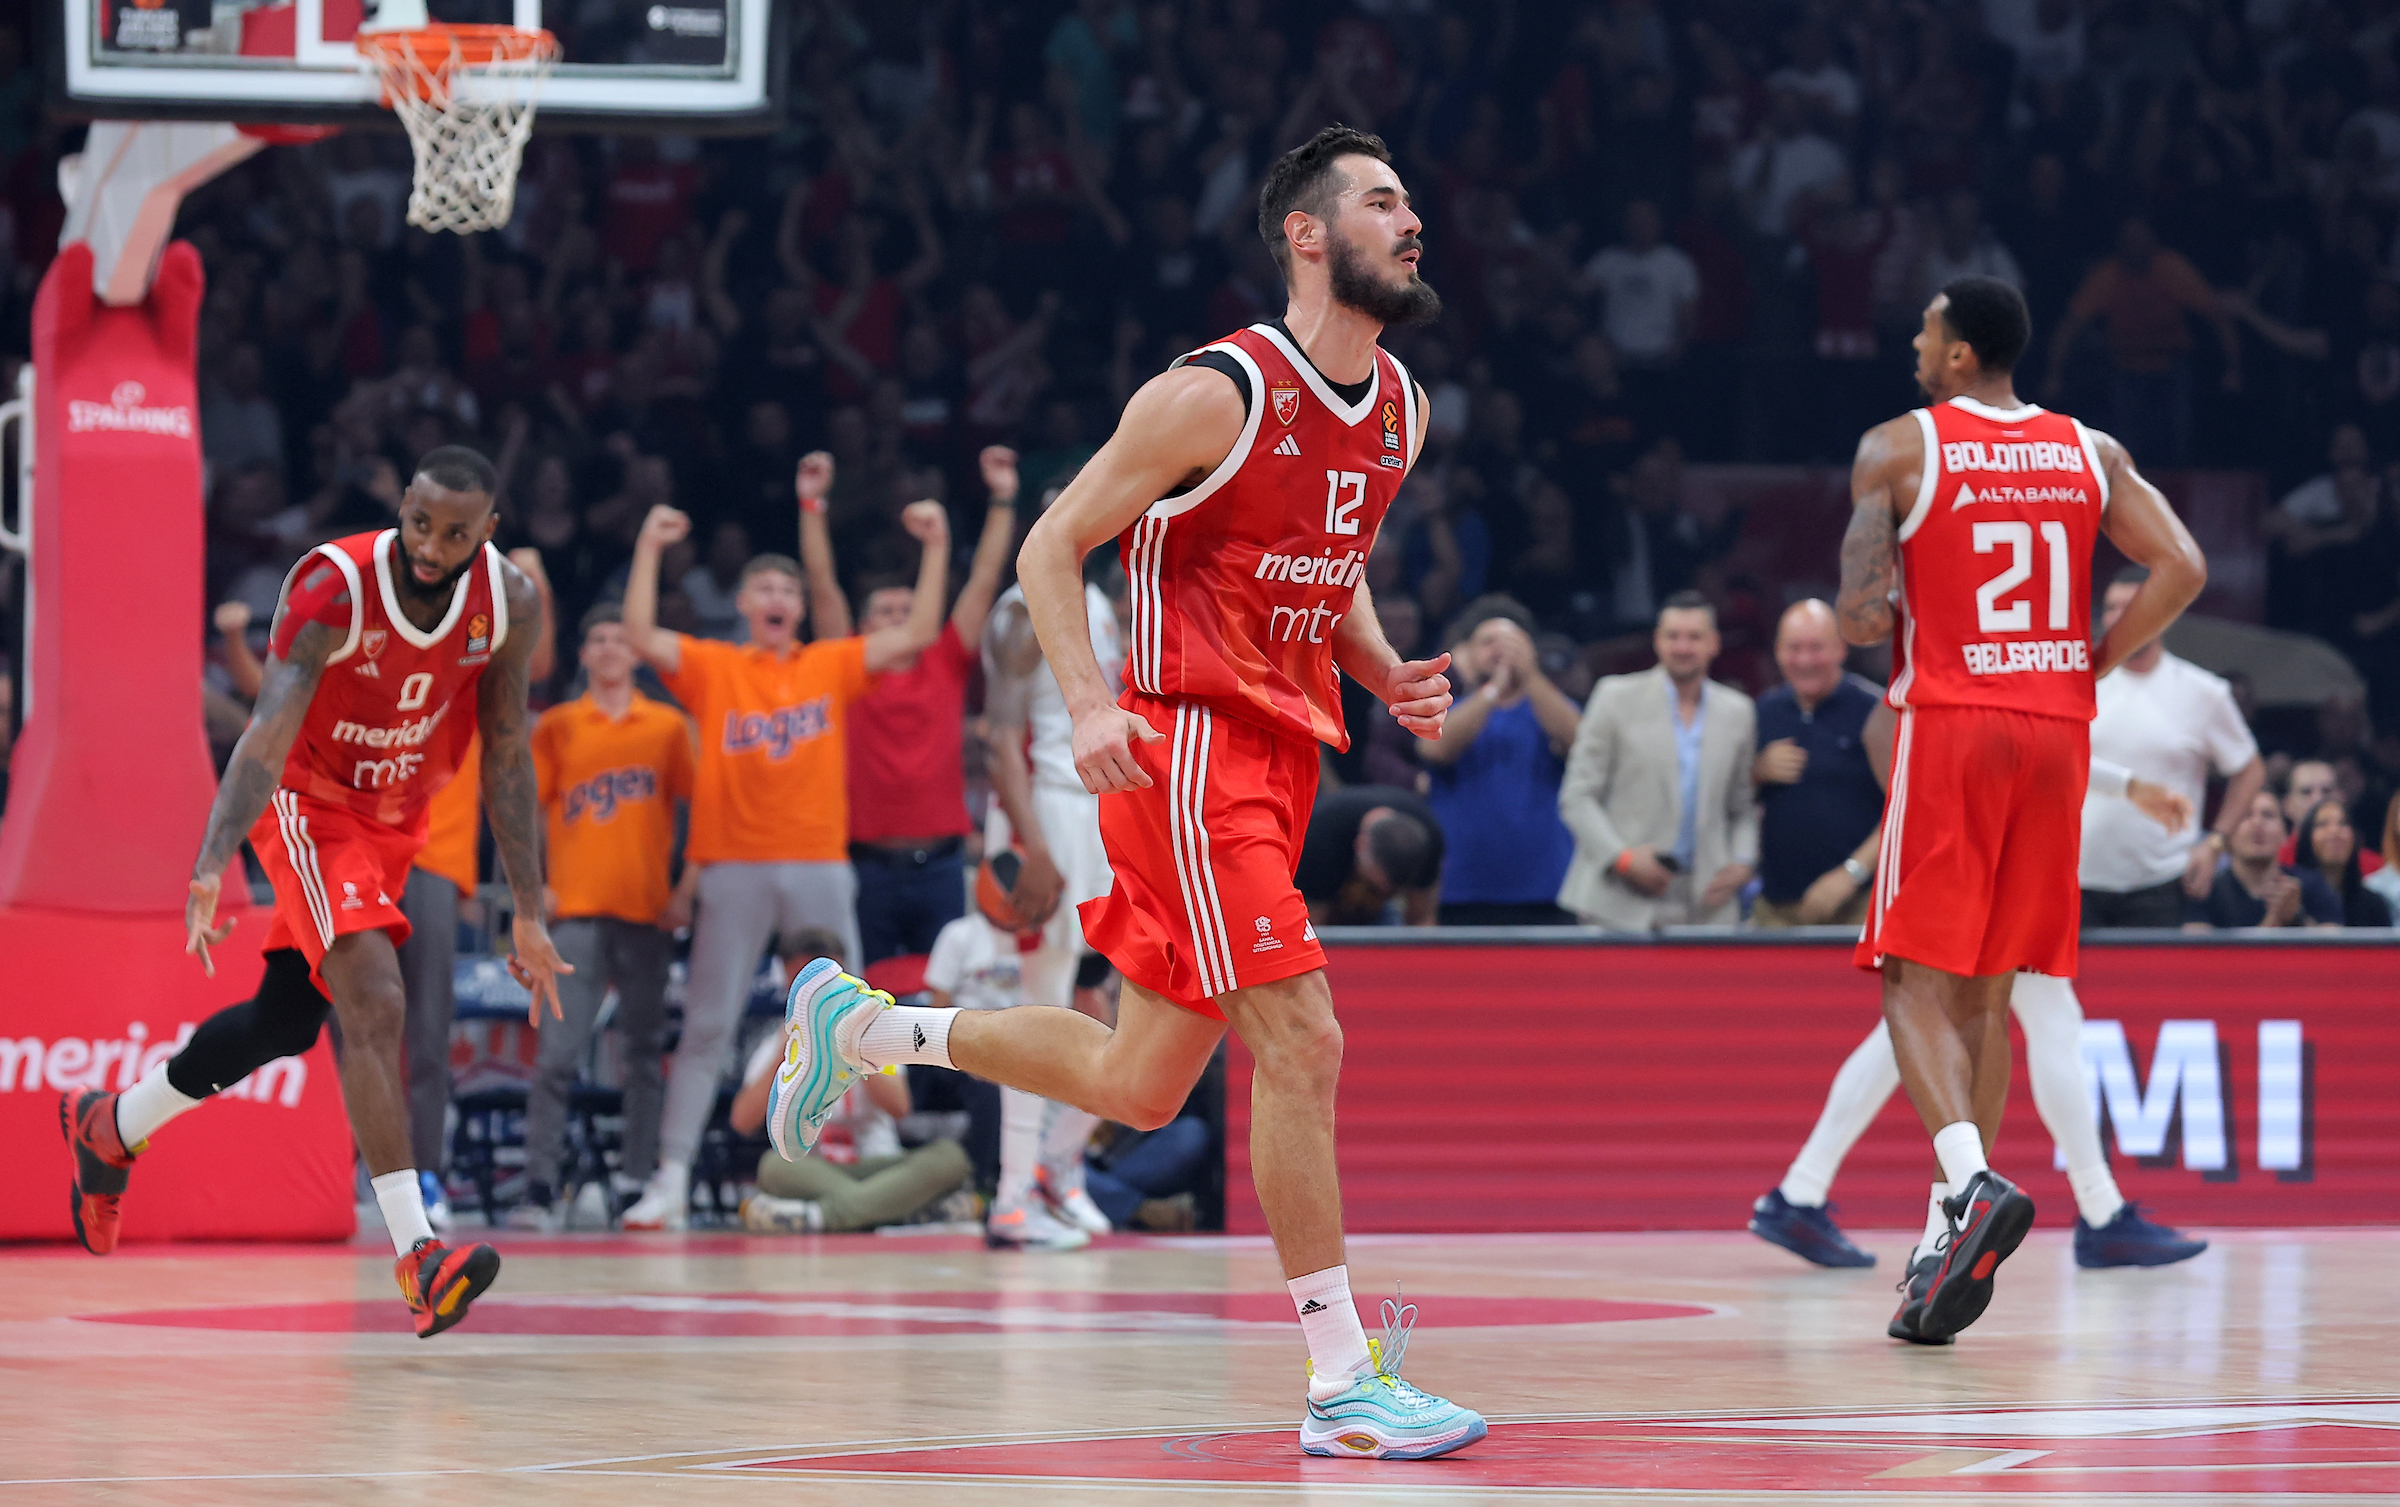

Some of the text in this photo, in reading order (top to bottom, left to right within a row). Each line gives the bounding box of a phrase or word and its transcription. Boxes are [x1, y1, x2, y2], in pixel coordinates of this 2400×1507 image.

[68, 399, 192, 439] SPALDING
[1942, 441, 2084, 473] BOLOMBOY
[1325, 469, 1368, 536] 12
[1977, 486, 2088, 504] ALTABANKA
[1972, 520, 2070, 633] 21
[1961, 640, 2089, 675] BELGRADE
[396, 672, 435, 711] 0
[331, 700, 450, 749] merid
[722, 694, 834, 763] Logex
[0, 1021, 309, 1108] meridn
